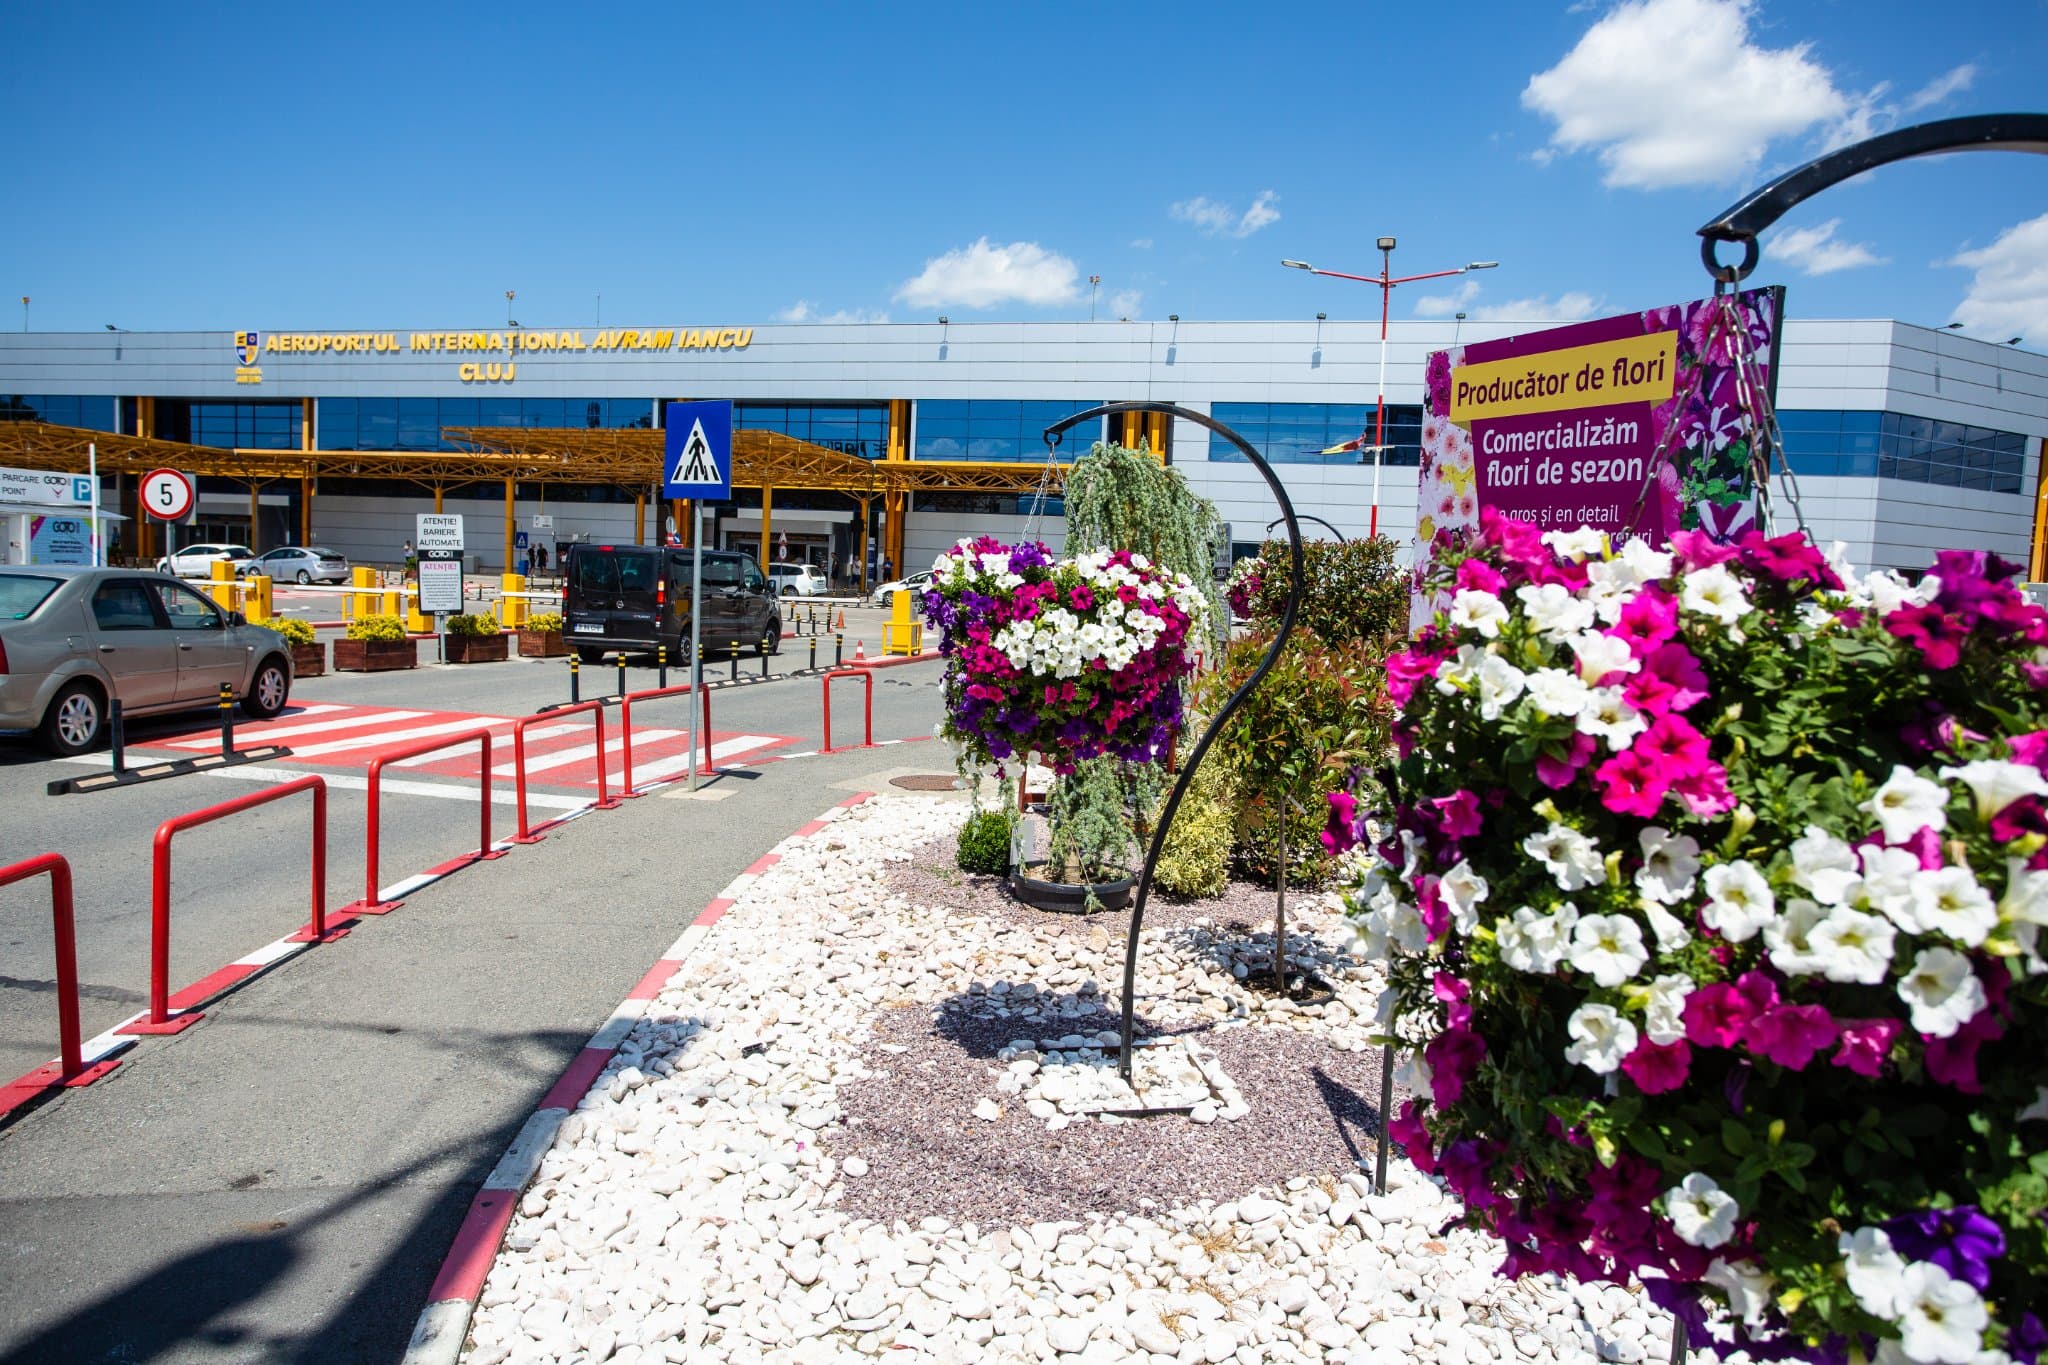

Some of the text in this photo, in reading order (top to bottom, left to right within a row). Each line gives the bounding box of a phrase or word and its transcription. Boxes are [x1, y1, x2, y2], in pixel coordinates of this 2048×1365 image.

[265, 328, 754, 358] AEROPORTUL INTERNAȚIONAL AVRAM IANCU
[459, 363, 515, 381] CLUJ
[1457, 350, 1666, 407] Producător de flori
[1482, 417, 1638, 455] Comercializăm
[2, 473, 40, 484] PARCARE
[1487, 457, 1643, 487] flori de sezon
[2, 487, 27, 496] POINT
[160, 483, 173, 506] 5
[1541, 505, 1552, 526] și
[1556, 508, 1573, 522] en
[1577, 504, 1620, 523] detail
[423, 528, 457, 536] BARIERE
